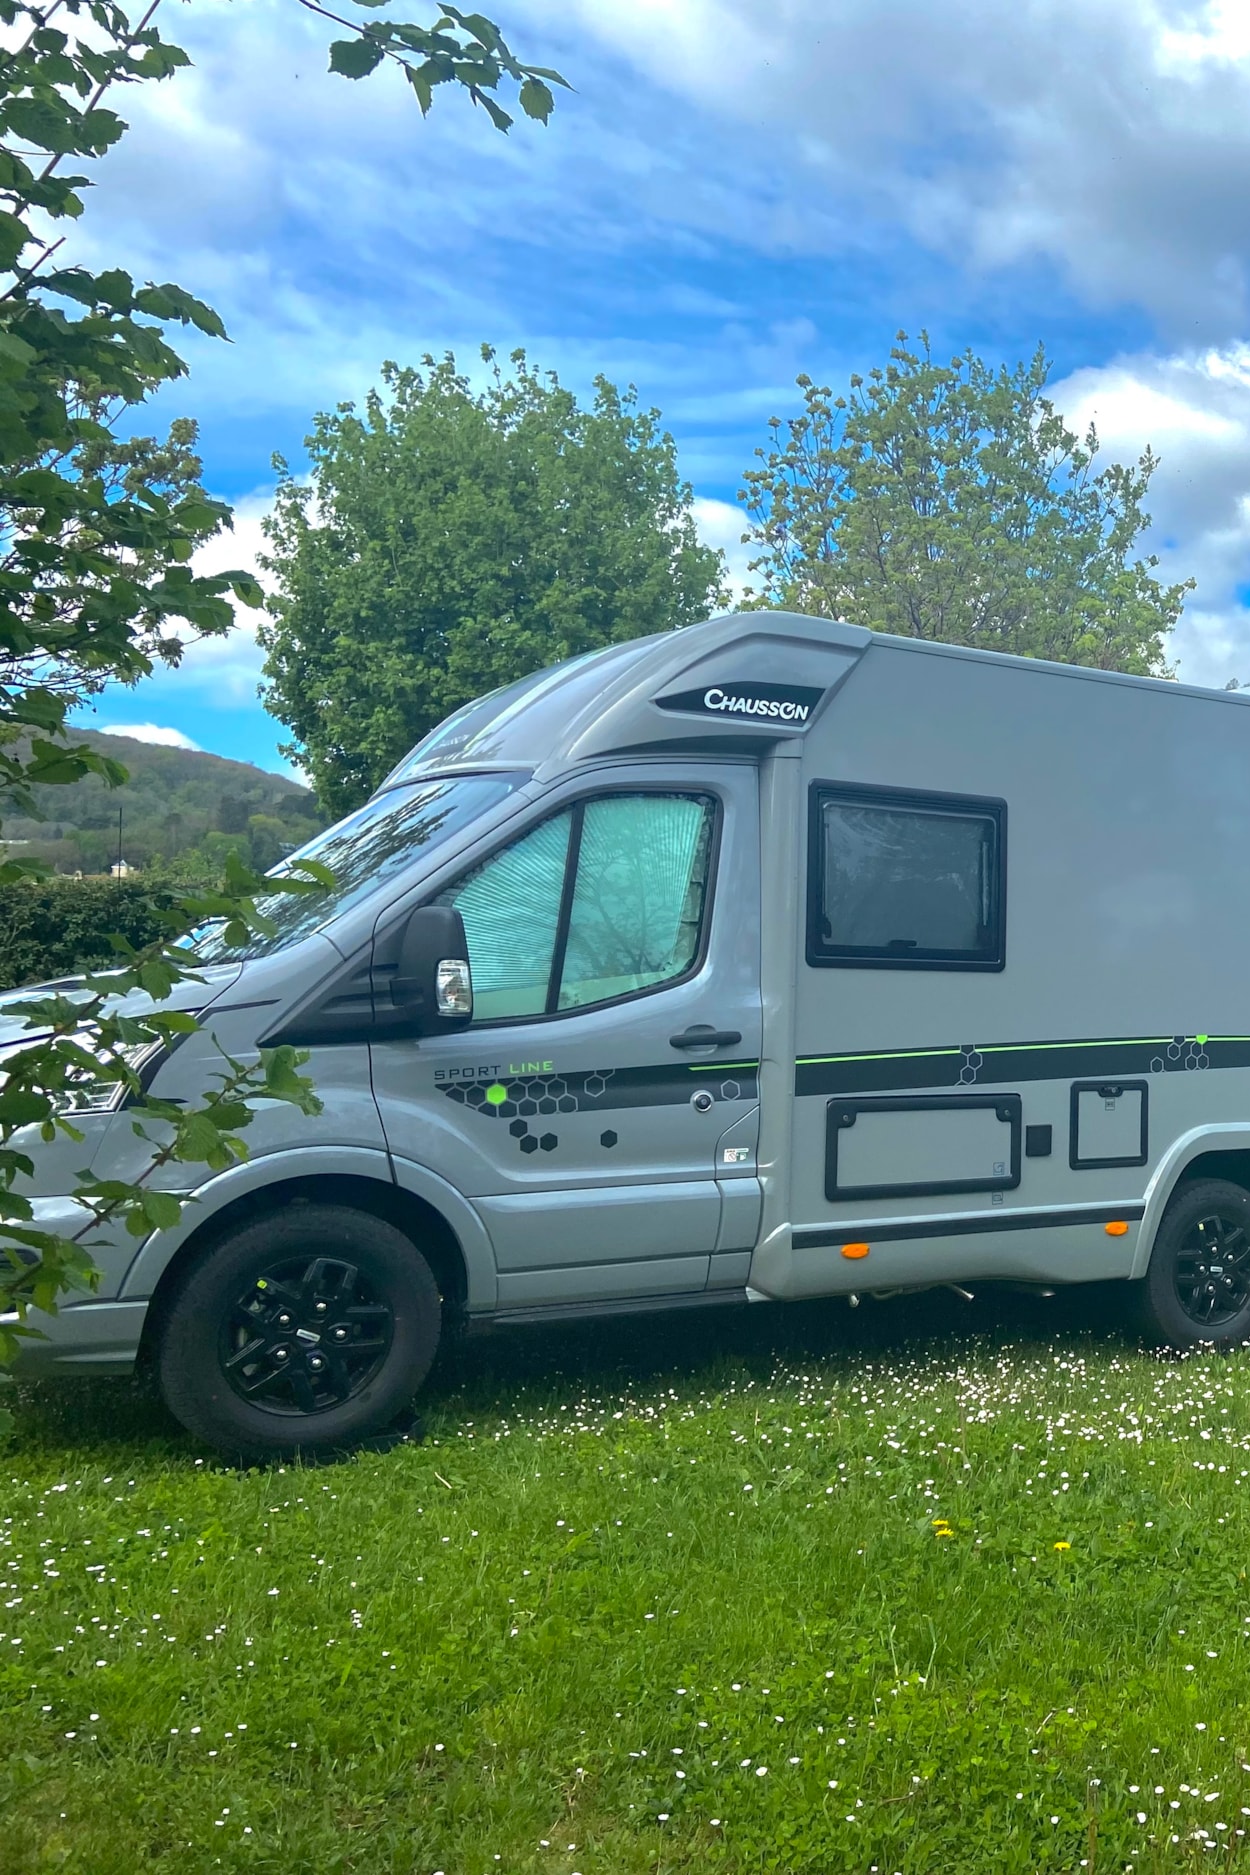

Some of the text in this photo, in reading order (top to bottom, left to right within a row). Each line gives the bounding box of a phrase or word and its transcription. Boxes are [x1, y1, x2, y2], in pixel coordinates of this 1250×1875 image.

[703, 688, 809, 720] CHAUSSON
[434, 1060, 554, 1080] SPORT LINE
